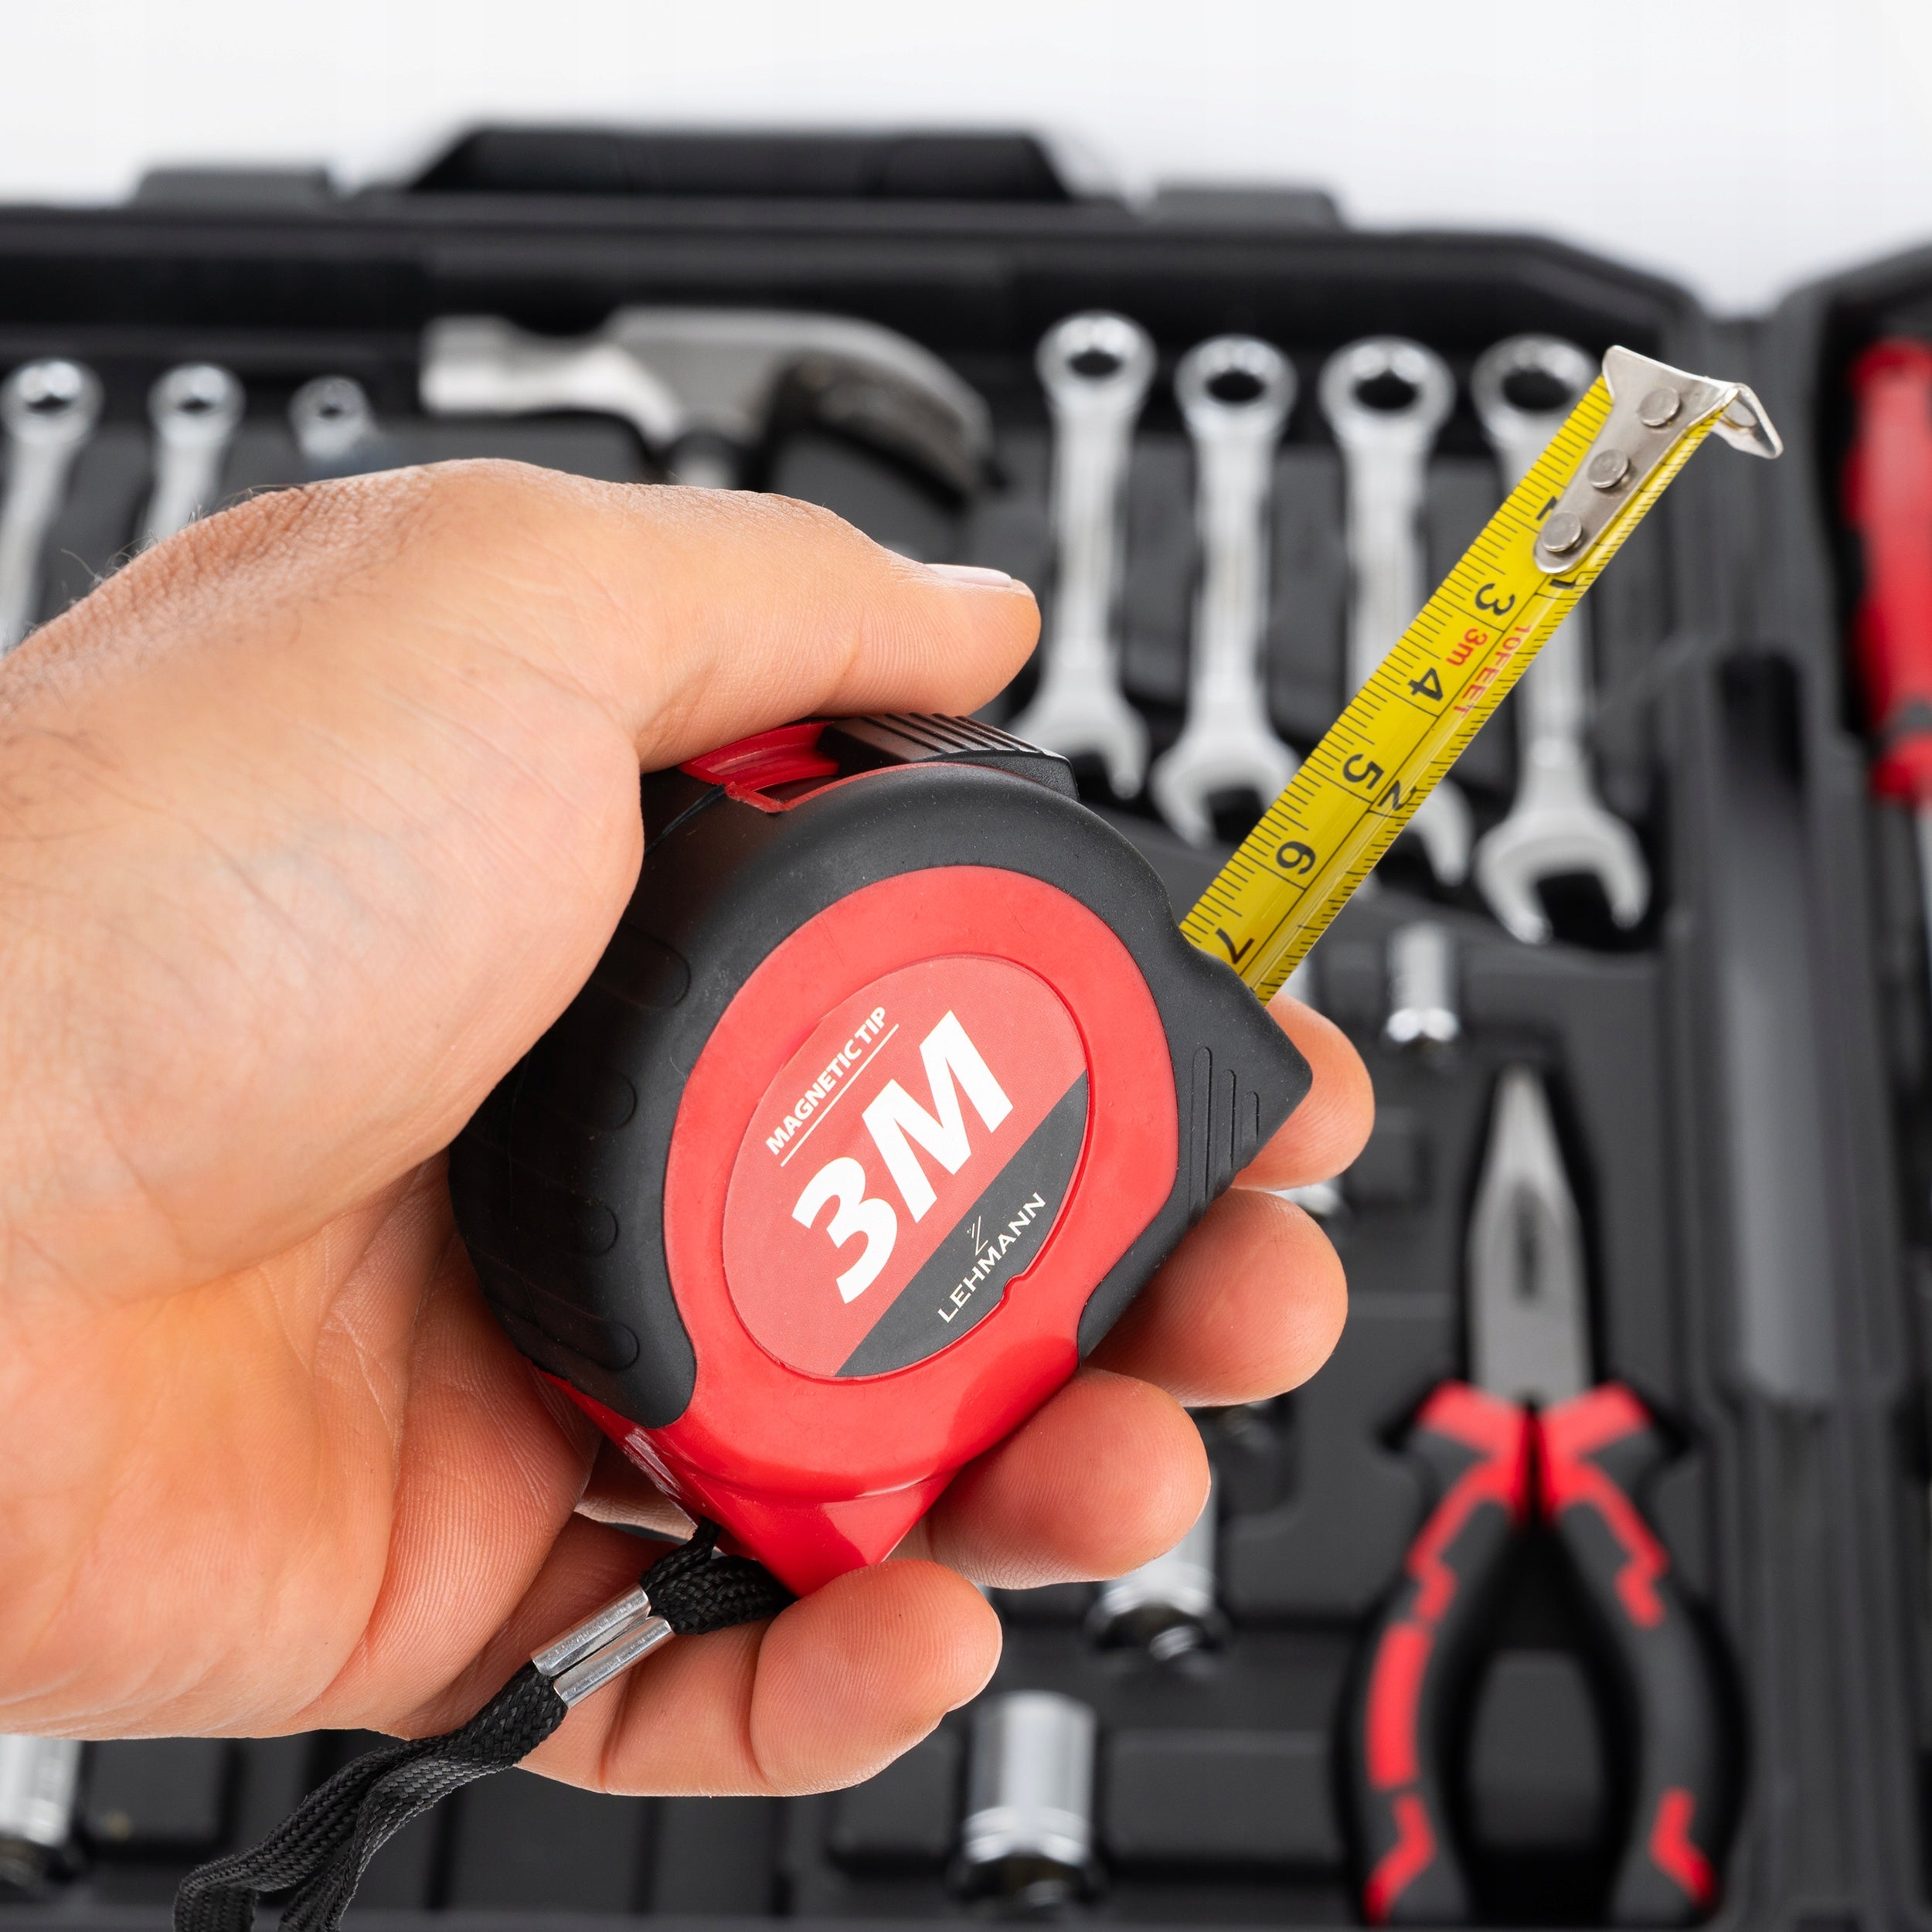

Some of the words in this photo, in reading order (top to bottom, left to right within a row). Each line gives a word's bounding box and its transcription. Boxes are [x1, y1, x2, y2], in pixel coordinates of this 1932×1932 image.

[1475, 583, 1515, 616] 3
[1446, 628, 1488, 666] 3m
[1407, 667, 1444, 702] 4
[1342, 753, 1385, 790] 5
[1377, 780, 1417, 811] 2
[1276, 840, 1316, 875] 6
[1215, 927, 1255, 964] 7
[765, 1039, 862, 1155] MAGNETIC
[854, 1006, 886, 1044] TIP
[791, 1009, 1014, 1304] 3M
[937, 1192, 1046, 1323] LEHMANN
